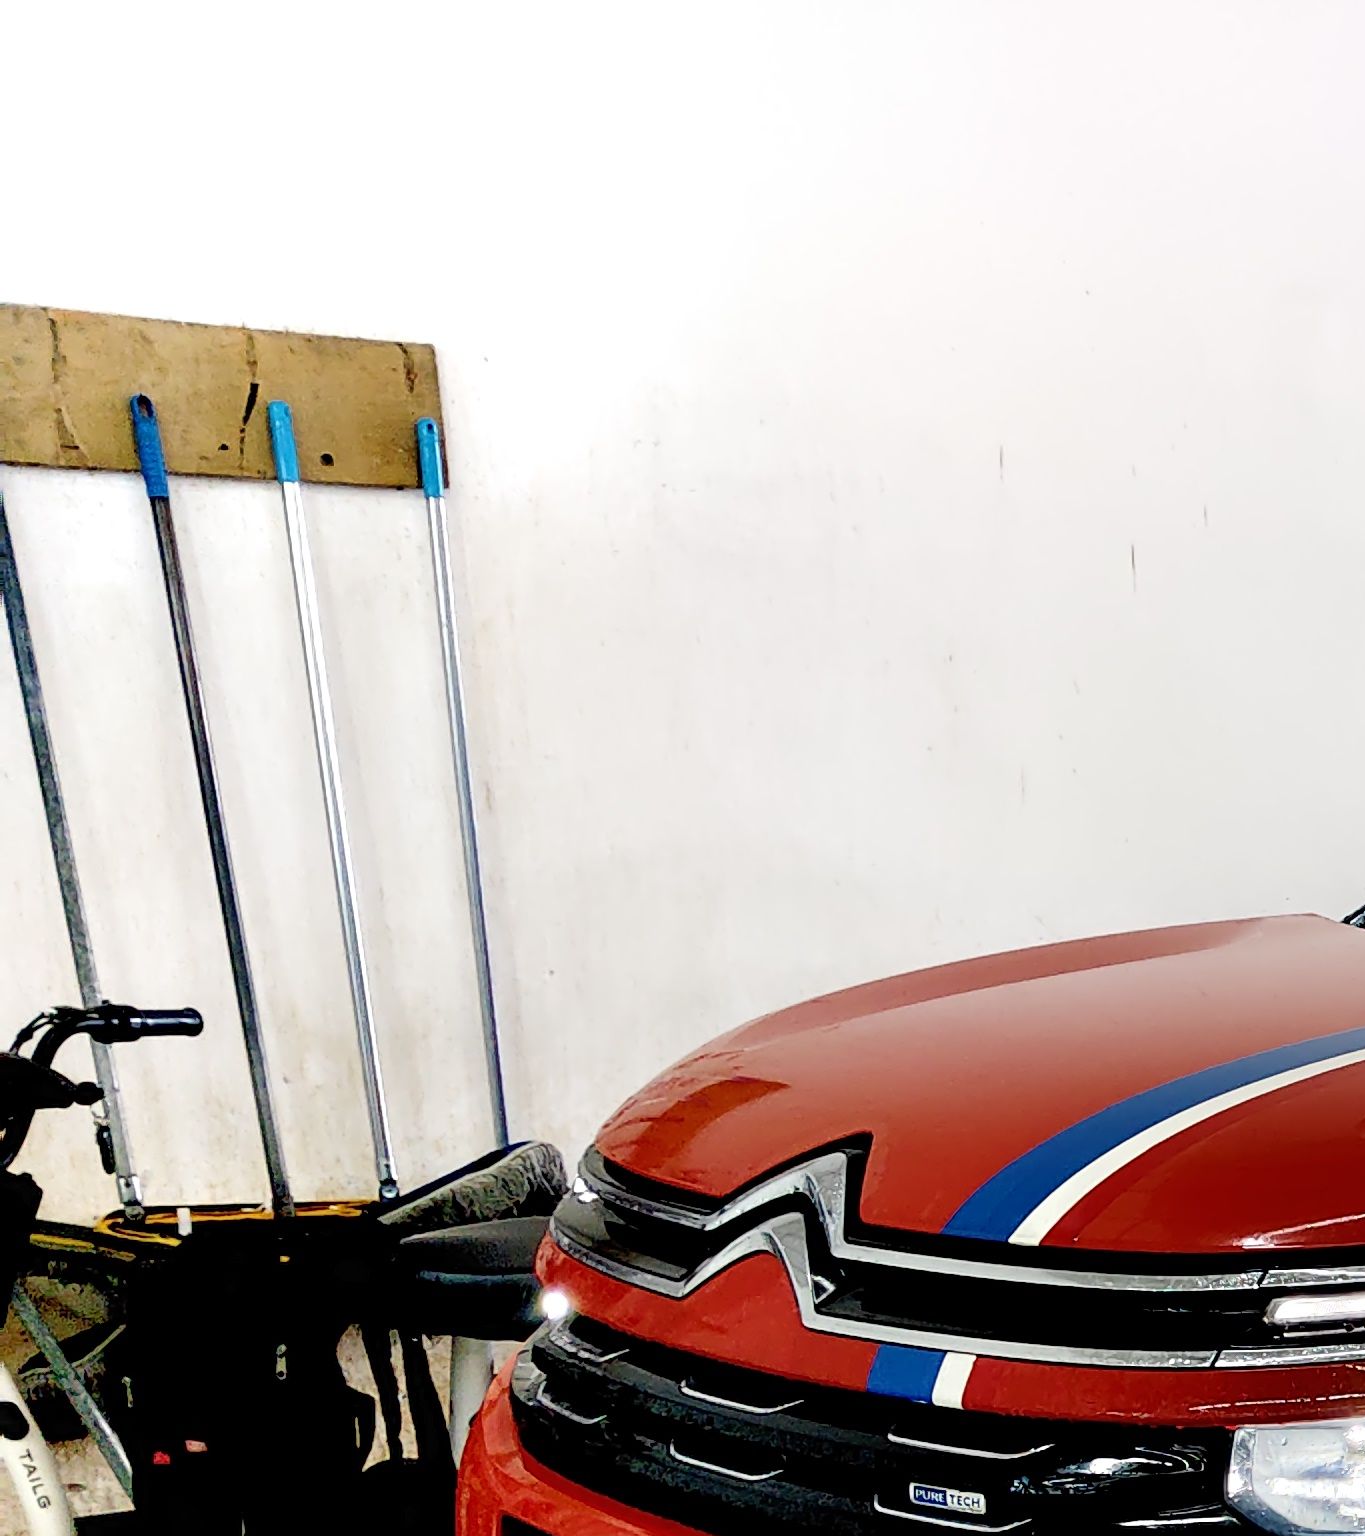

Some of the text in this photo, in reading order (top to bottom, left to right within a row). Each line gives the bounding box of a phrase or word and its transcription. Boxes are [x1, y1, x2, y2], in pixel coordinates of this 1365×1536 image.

[19, 1448, 52, 1510] TAILG
[914, 1488, 981, 1509] PURE TECH
